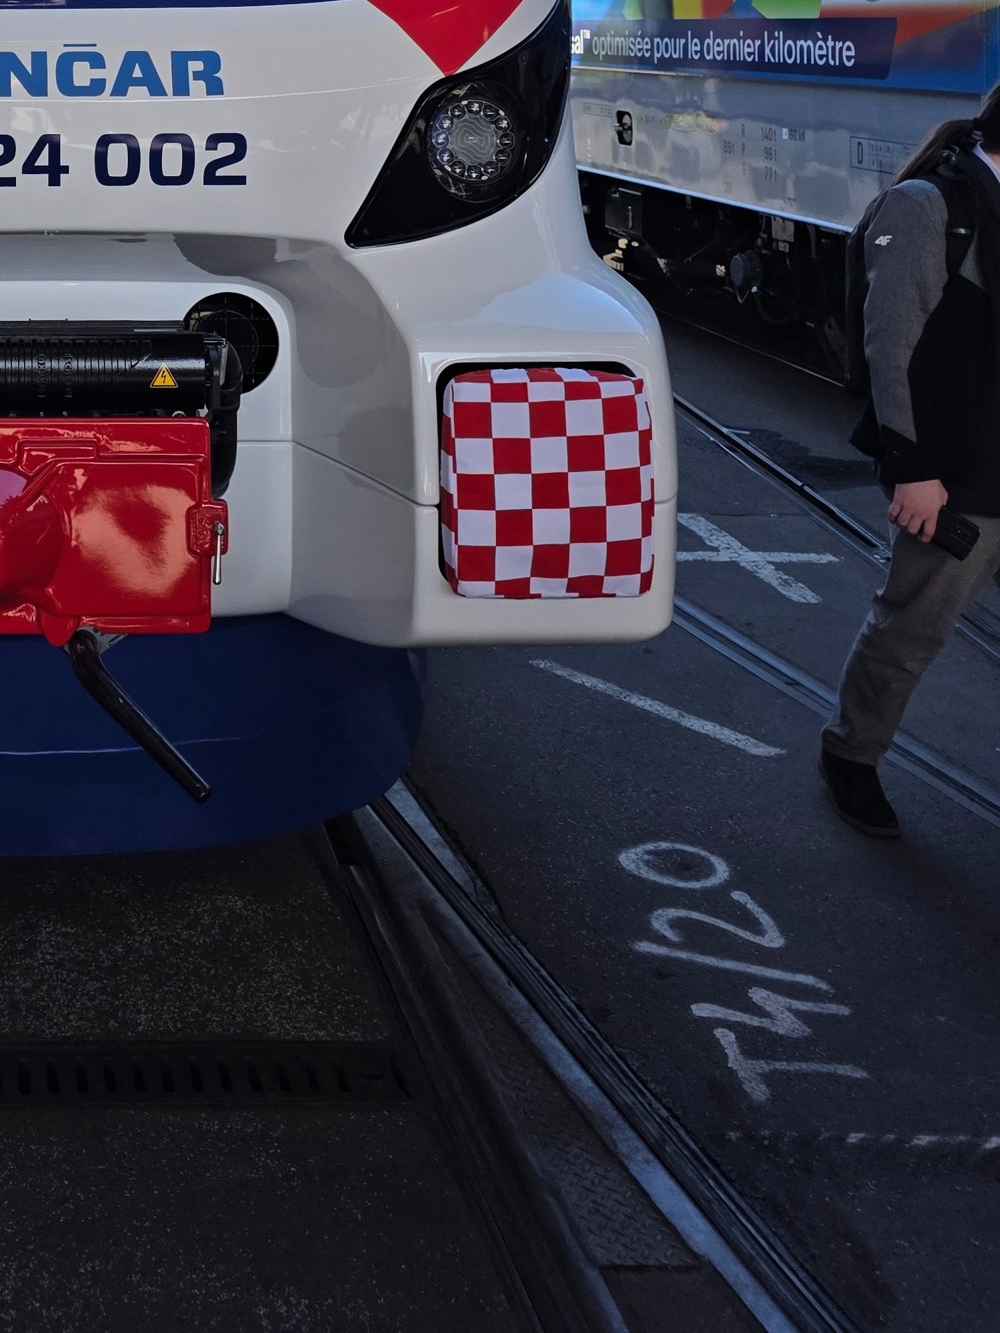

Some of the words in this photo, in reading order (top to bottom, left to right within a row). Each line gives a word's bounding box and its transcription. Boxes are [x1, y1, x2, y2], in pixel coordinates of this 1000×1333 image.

[592, 30, 651, 61] optimisée
[653, 37, 685, 64] pour
[687, 31, 701, 60] le
[704, 31, 760, 62] dernier
[764, 30, 856, 67] kilomètre
[94, 132, 248, 187] 002
[874, 235, 893, 246] 4F
